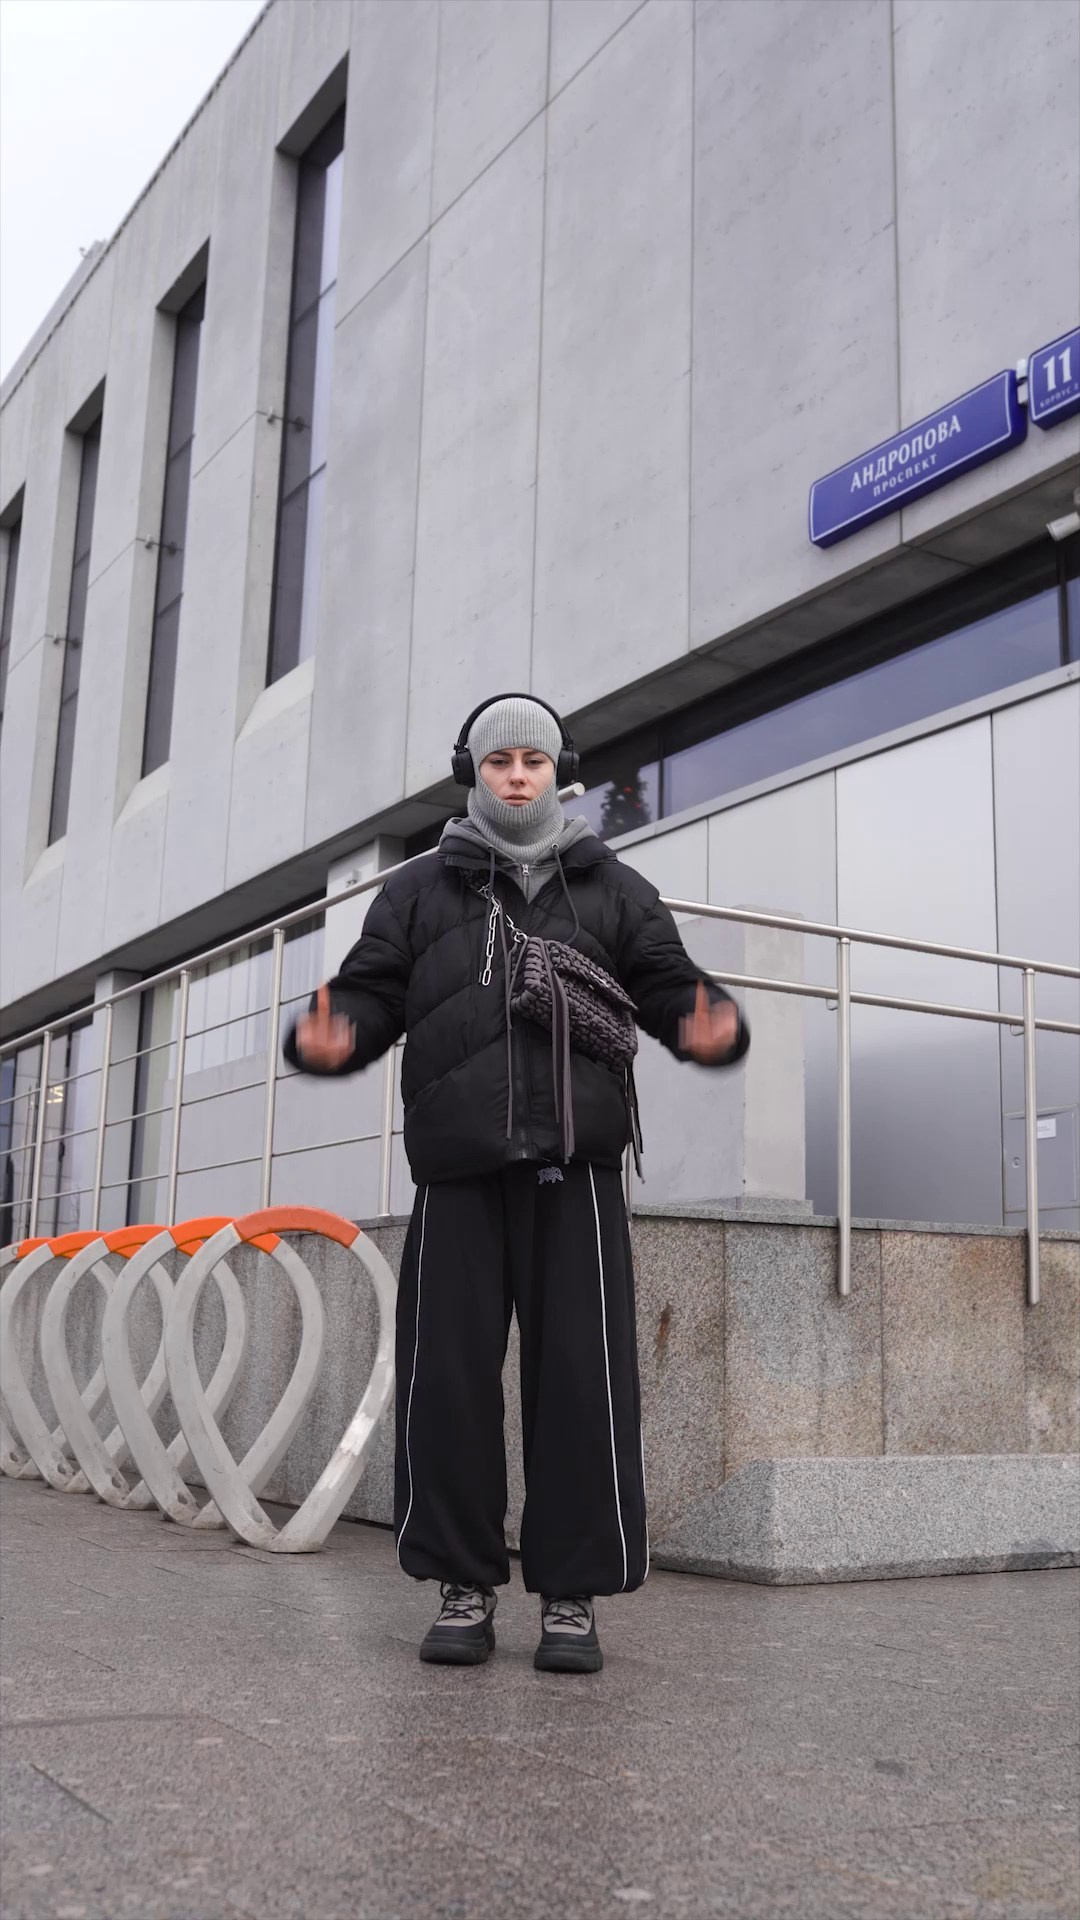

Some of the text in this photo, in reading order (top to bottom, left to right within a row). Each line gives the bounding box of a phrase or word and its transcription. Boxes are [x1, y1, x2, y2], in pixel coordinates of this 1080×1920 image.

[1042, 346, 1072, 392] 11
[850, 414, 961, 493] АНДРОПОВА
[873, 453, 937, 497] ПРОСПЕКТ
